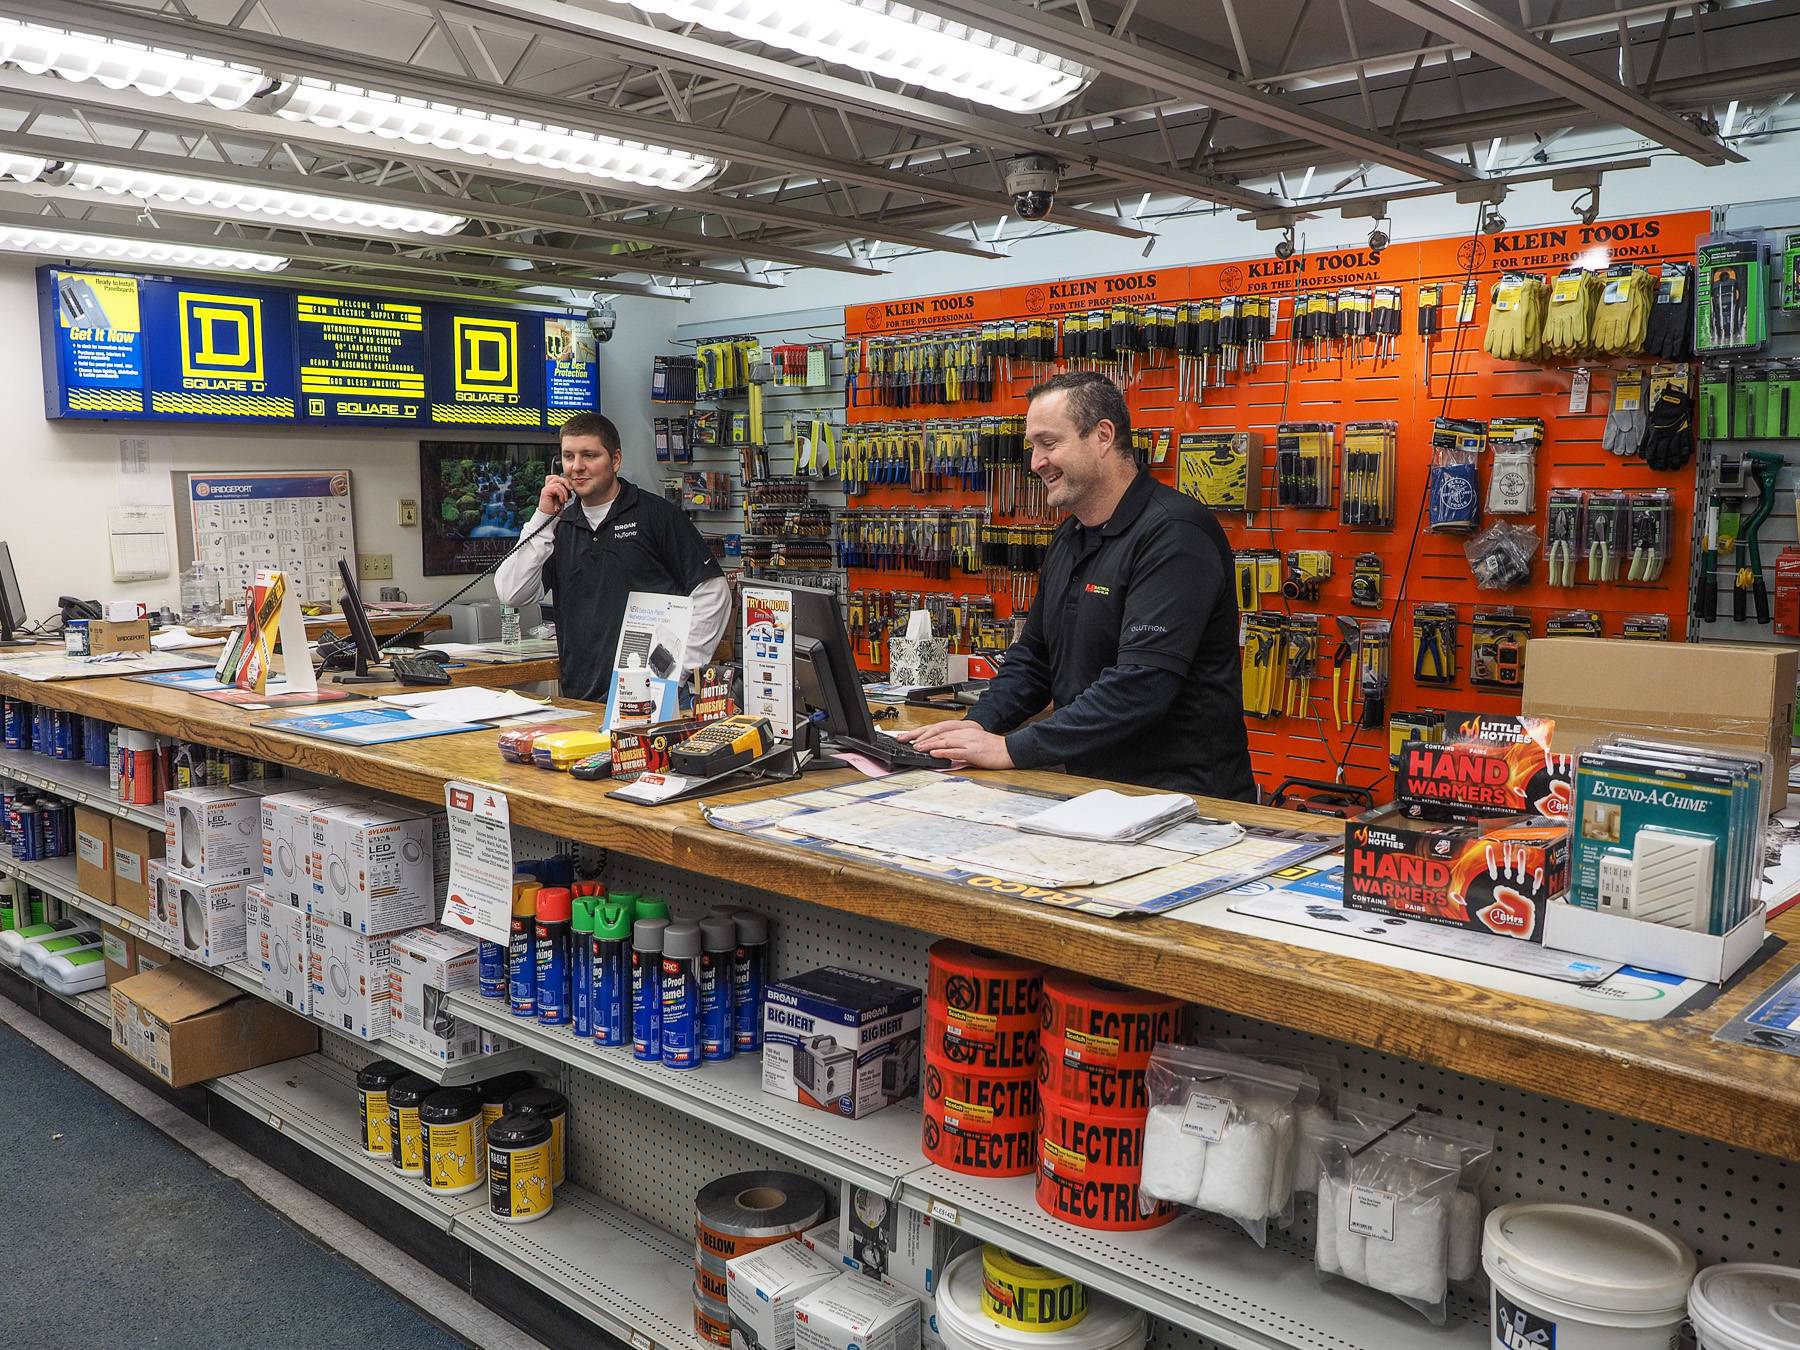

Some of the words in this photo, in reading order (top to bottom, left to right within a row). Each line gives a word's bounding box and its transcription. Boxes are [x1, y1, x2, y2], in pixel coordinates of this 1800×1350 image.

[1493, 231, 1568, 253] KLEIN
[1579, 221, 1660, 245] TOOLS
[1247, 257, 1308, 278] KLEIN
[1315, 251, 1381, 269] TOOLS
[1492, 257, 1517, 269] FOR
[1520, 256, 1546, 267] THE
[1049, 281, 1097, 299] KLEIN
[1103, 274, 1157, 293] TOOLS
[1247, 280, 1269, 292] FOR
[1271, 278, 1293, 290] THE
[1295, 270, 1381, 287] PROFESSIONAL
[339, 300, 371, 310] WELCOME
[884, 303, 925, 317] KLEIN
[931, 296, 975, 312] TOOLS
[1049, 301, 1067, 311] FOR
[1068, 299, 1086, 310] THE
[1088, 292, 1157, 307] PROFESSIONAL
[333, 308, 365, 317] ELECTRIC
[371, 312, 395, 320] SUPPLY
[885, 319, 900, 328] FOR
[901, 317, 916, 327] THE
[917, 312, 975, 326] PROFESSIONAL
[70, 327, 92, 341] Get
[95, 329, 106, 342] It
[108, 330, 135, 344] Now
[323, 324, 360, 334] AUTHORIZED
[362, 328, 401, 337] DISTRIBUTOR
[359, 336, 374, 344] LOAD
[376, 338, 402, 346] CENTERS
[366, 346, 392, 354] CENTERS
[336, 352, 358, 360] SAFETY
[360, 354, 389, 362] SWITCHES
[342, 361, 372, 369] ASSEMBLE
[374, 364, 414, 372] PANELBOARDS
[556, 360, 571, 370] Your
[572, 360, 586, 370] Best
[554, 368, 588, 378] Protection
[182, 379, 247, 391] SQUARE
[347, 379, 368, 387] BLESS
[455, 392, 505, 403] SQUARE
[336, 402, 399, 415] SQUARE
[210, 484, 253, 494] BRIDGEPORT
[747, 598, 759, 610] TRY
[760, 599, 767, 610] IT
[768, 600, 789, 612] NOW!
[117, 634, 145, 642] BRIDGEPORT
[703, 684, 728, 698] HOTTIES
[696, 699, 726, 715] ADHESIVE
[1480, 721, 1522, 733] LITTLE
[1480, 730, 1530, 744] HOTTIES
[620, 748, 646, 759] ADHESIVE
[1424, 743, 1455, 752] CONTAINS
[1409, 750, 1510, 785] HAND
[1582, 758, 1603, 766] Carlon
[1408, 779, 1505, 805] WARMERS
[207, 801, 237, 810] SYLVANIA
[1483, 806, 1517, 814] AIR-ACTIVATED
[262, 817, 273, 827] LED
[313, 831, 324, 842] LED
[368, 826, 401, 836] SYLVANIA
[1368, 831, 1397, 841] LITTLE
[368, 843, 391, 854] LED
[1368, 838, 1404, 850] HOTTIES
[1353, 850, 1451, 888] HAND
[211, 883, 240, 894] SYLVANIA
[1352, 877, 1448, 906] WARMERS
[211, 897, 228, 906] LED
[1352, 894, 1387, 906] CONTAINS
[1404, 903, 1426, 912] PAIRS
[247, 904, 258, 913] LED
[260, 912, 271, 922] LED
[312, 933, 324, 944] LED
[369, 931, 401, 941] SYLVANIA
[370, 947, 391, 959] LED
[391, 957, 401, 966] LED
[448, 959, 476, 969] SYLVANIA
[663, 961, 677, 971] CRC
[668, 974, 685, 986] Proof
[824, 965, 880, 984] BROAN
[767, 990, 798, 1007] BROAN
[671, 1003, 686, 1012] Primer
[861, 1005, 888, 1022] BROAN
[948, 1008, 966, 1020] Scotch
[768, 1007, 786, 1024] BIG
[787, 1012, 816, 1034] HEAT
[861, 1023, 879, 1044] BIG
[880, 1015, 904, 1036] HEAT
[1065, 1031, 1086, 1044] Scotch
[962, 1077, 1041, 1118] LECTRI
[945, 1100, 963, 1112] Scotch
[490, 1152, 508, 1161] KLEIN
[954, 1132, 1038, 1169] LECTRI
[490, 1158, 508, 1166] TOOLS
[703, 1231, 736, 1255] BELOW
[803, 1239, 815, 1252] 3M
[727, 1268, 736, 1282] 3M
[795, 1310, 809, 1324] 3M
